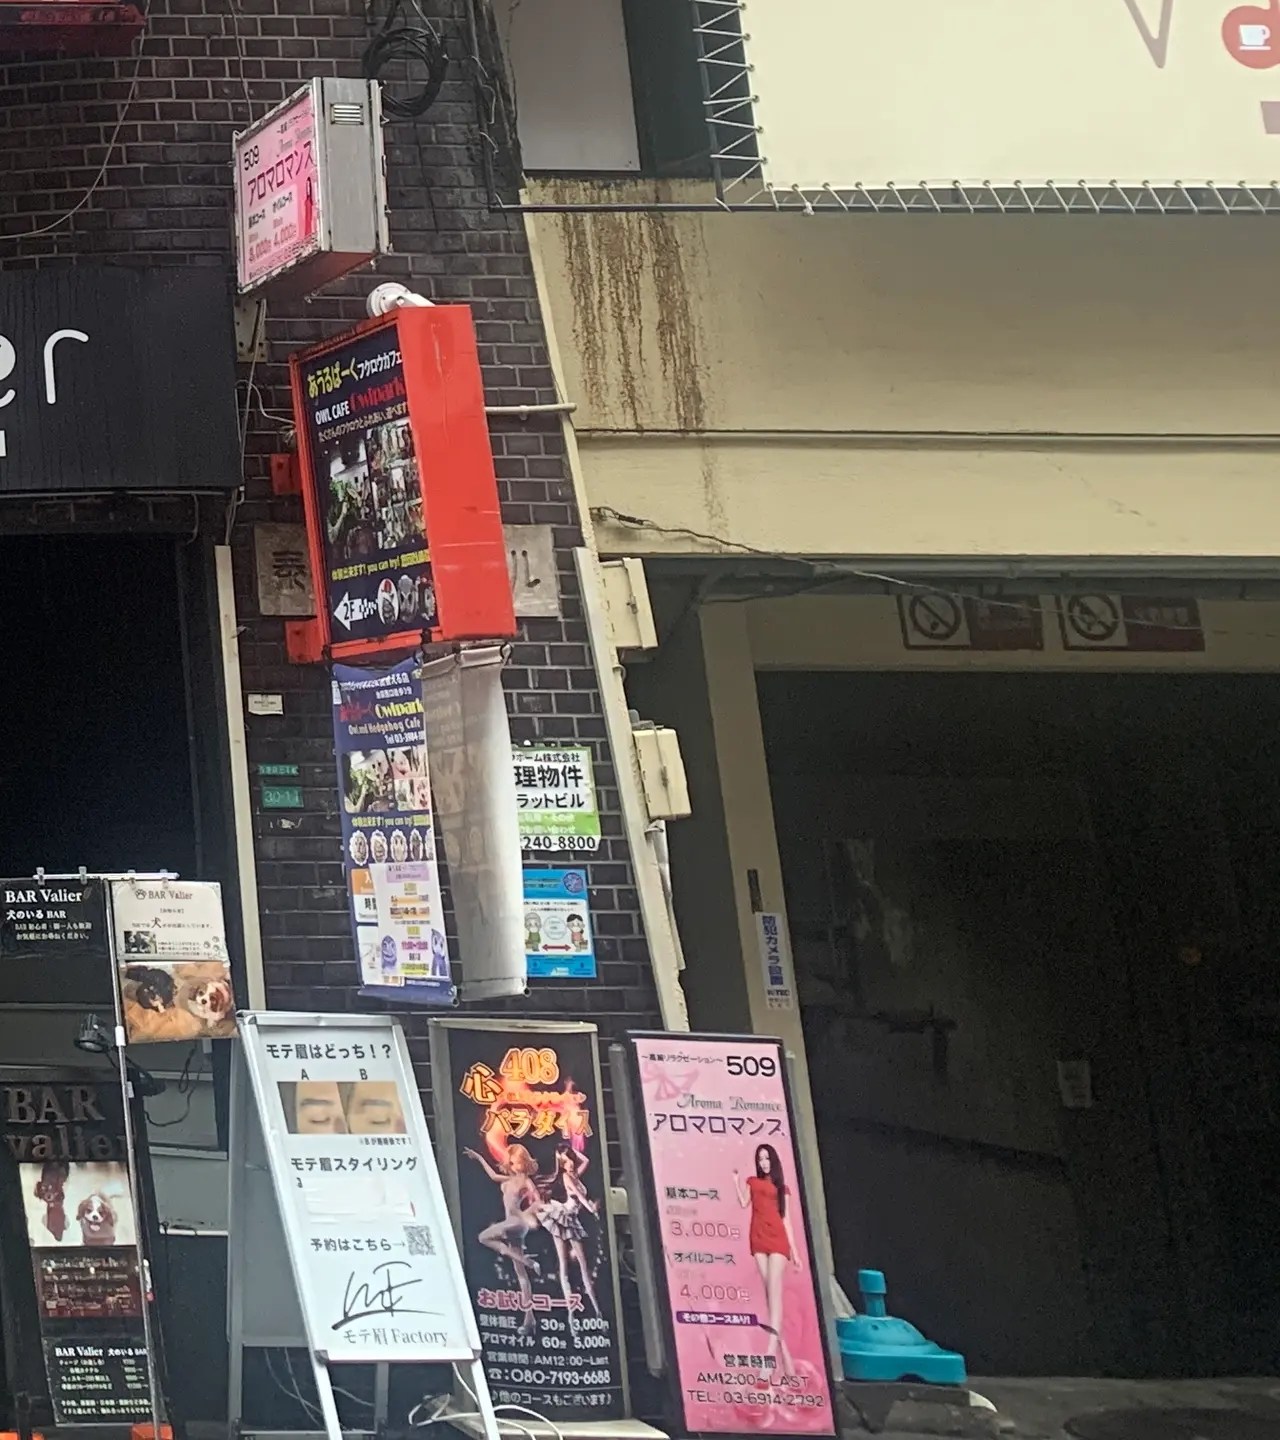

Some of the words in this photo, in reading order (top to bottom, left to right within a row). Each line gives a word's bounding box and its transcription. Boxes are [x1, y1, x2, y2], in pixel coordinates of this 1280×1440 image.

[244, 145, 260, 171] 509
[247, 140, 316, 207] アロマロマンス
[315, 408, 333, 425] OWL
[332, 400, 351, 419] CAFE
[343, 601, 355, 621] 2F
[512, 753, 582, 763] ホーム株式会社
[516, 793, 585, 809] ラットビル
[521, 836, 596, 850] 240-8800
[4, 889, 38, 903] BAR
[39, 888, 83, 903] Valier
[148, 890, 166, 900] BAR
[168, 890, 193, 900] Valier
[6, 909, 44, 921] 犬のいる
[46, 910, 67, 919] BAR
[499, 1047, 560, 1085] 408
[726, 1055, 777, 1077] 509
[300, 1068, 310, 1081] A
[358, 1068, 369, 1081] B
[459, 1061, 505, 1106] 心
[4, 1085, 106, 1124] BAR
[480, 1108, 594, 1139] パラダイス
[652, 1113, 782, 1136] アロマロマンス
[2, 1124, 128, 1161] valier
[290, 1156, 418, 1172] モテ眉スタイリング
[665, 1186, 720, 1200] 基本コース
[673, 1252, 737, 1265] オイルコース
[477, 1288, 585, 1312] お試しコース
[540, 1318, 566, 1331] 30分
[390, 1327, 448, 1348] Factory
[541, 1336, 568, 1349] 60分
[54, 1347, 76, 1357] BAR
[723, 1353, 778, 1369] 営業時間
